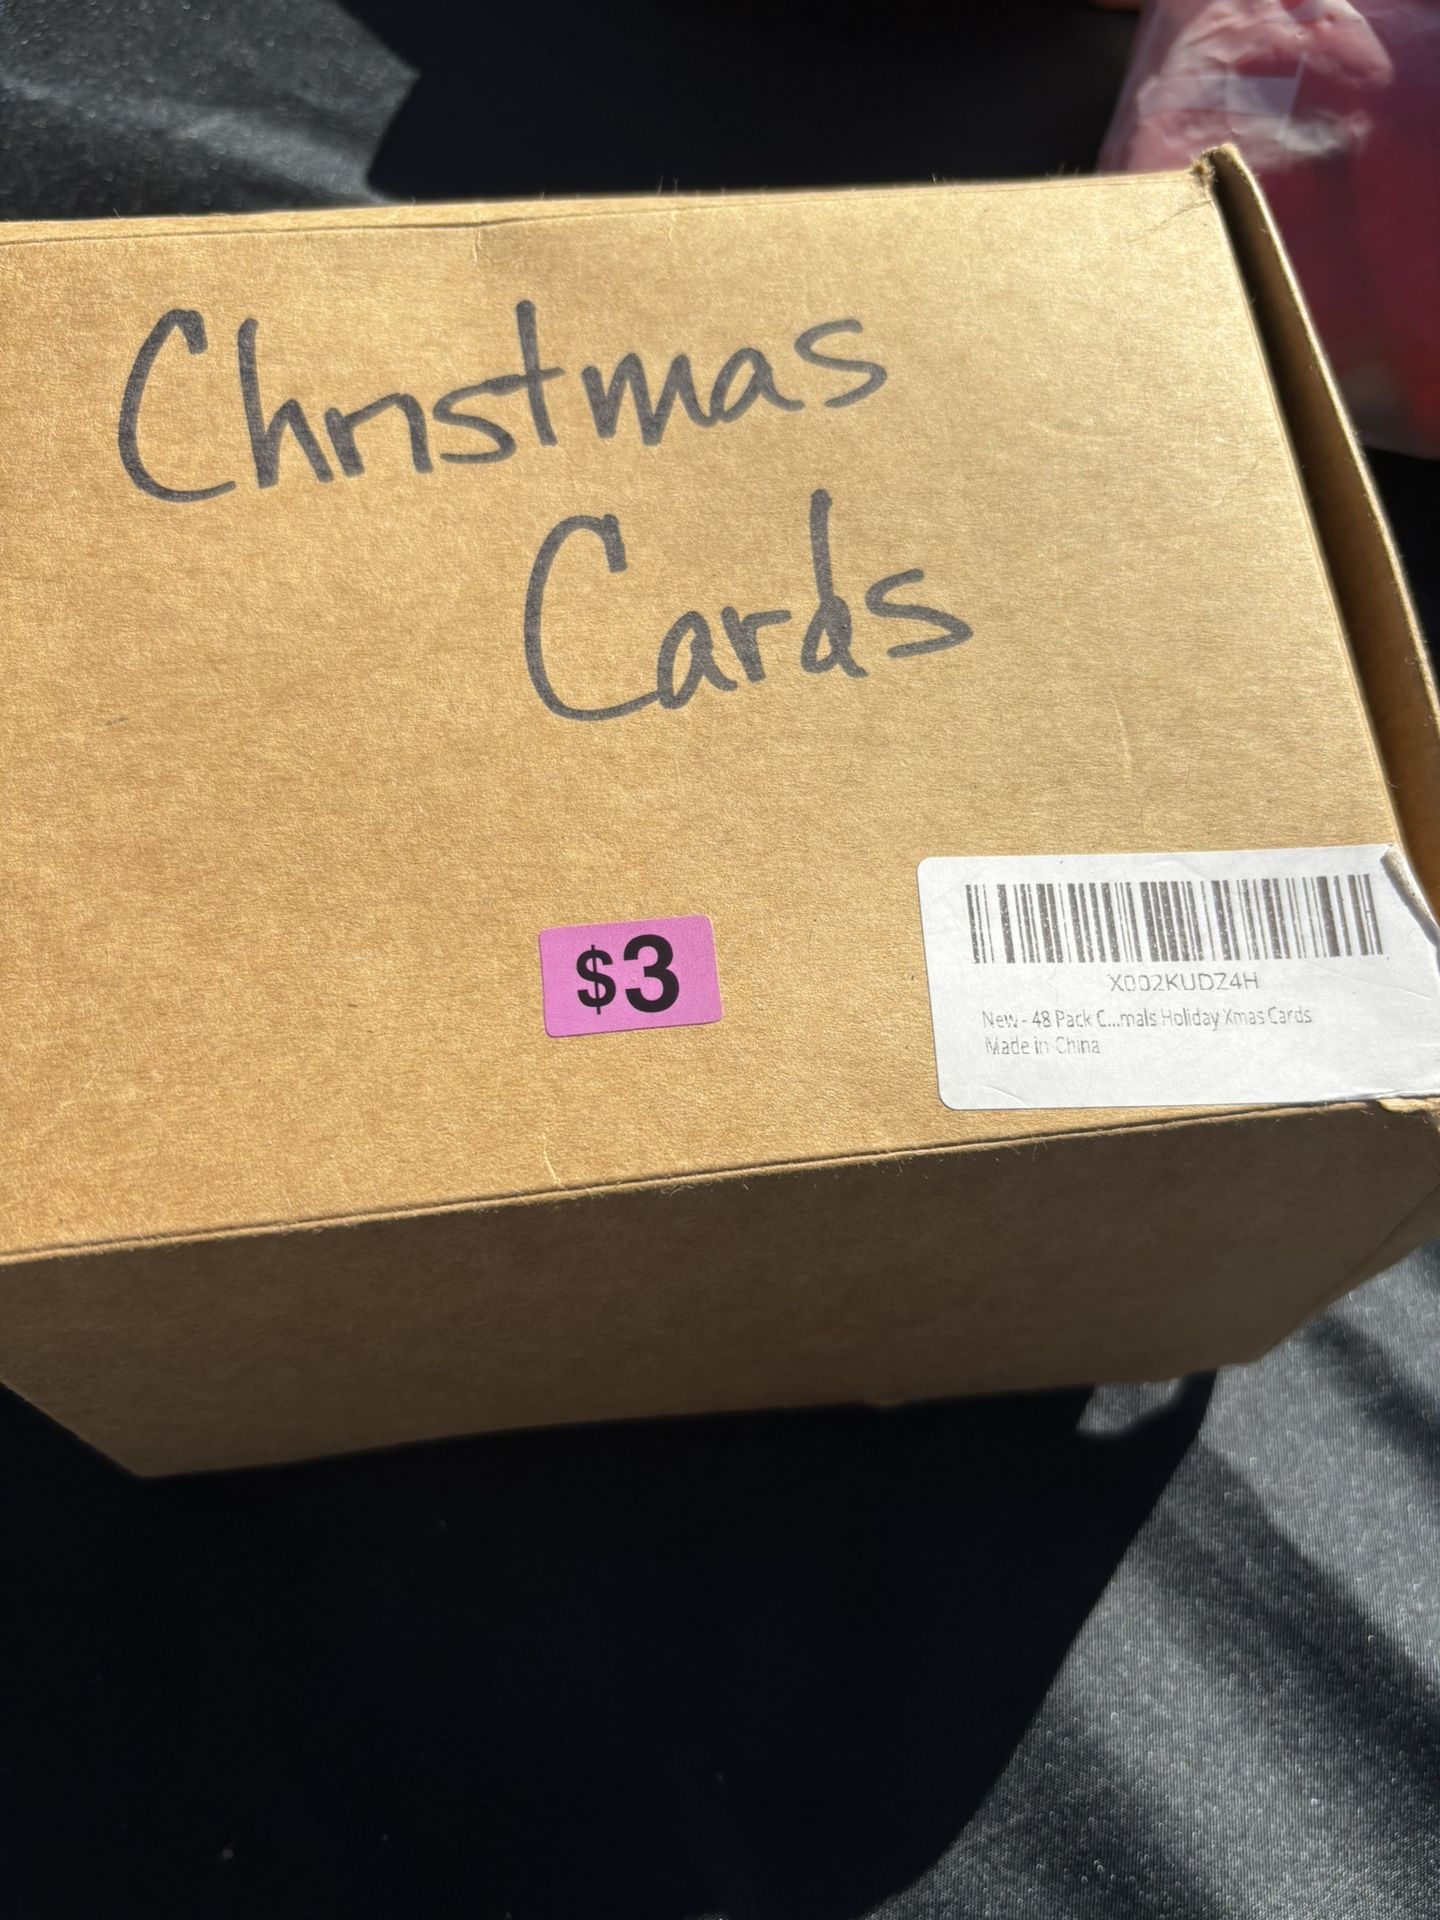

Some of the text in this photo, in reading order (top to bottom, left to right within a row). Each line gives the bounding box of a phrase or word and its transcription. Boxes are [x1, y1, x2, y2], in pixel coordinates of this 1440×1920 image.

[118, 300, 888, 503] Christmas
[523, 489, 974, 721] Cards
[576, 934, 680, 1015] $3
[1107, 972, 1260, 992] X002KUDZ4H
[985, 1036, 1101, 1055] Made in China
[1032, 1010, 1051, 1028] 48
[1055, 1009, 1091, 1028] Pack
[1096, 1008, 1158, 1028] C...mals
[1161, 1007, 1220, 1032] Holiday
[1222, 1007, 1266, 1026] Xmas
[1267, 1005, 1313, 1025] Cards
